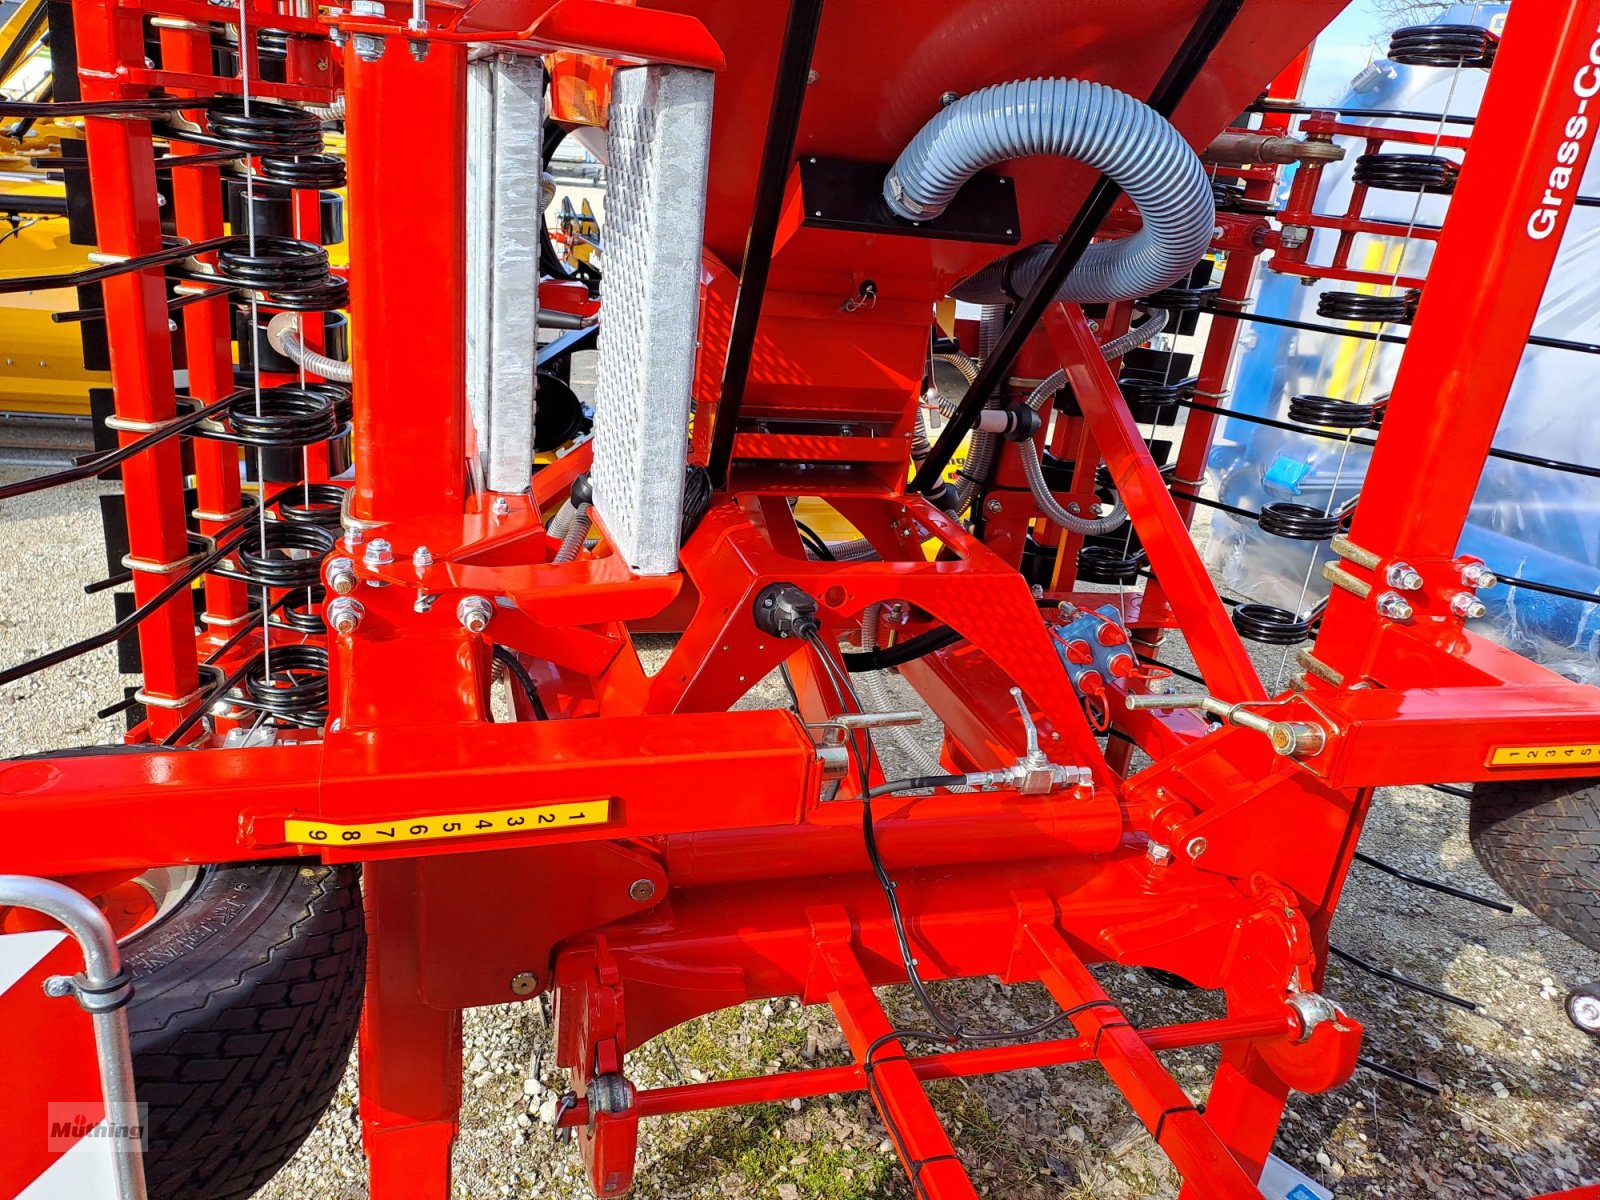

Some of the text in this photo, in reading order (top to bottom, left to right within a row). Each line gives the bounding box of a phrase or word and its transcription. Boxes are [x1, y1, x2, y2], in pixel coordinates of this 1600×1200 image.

[1527, 18, 1600, 240] Grass-Co
[507, 816, 524, 826] 3
[538, 813, 555, 823] 2
[443, 822, 461, 832] 5
[475, 819, 493, 829] 4
[376, 827, 395, 837] 7
[409, 824, 428, 835] 6
[308, 830, 327, 840] 9
[342, 830, 361, 841] 8
